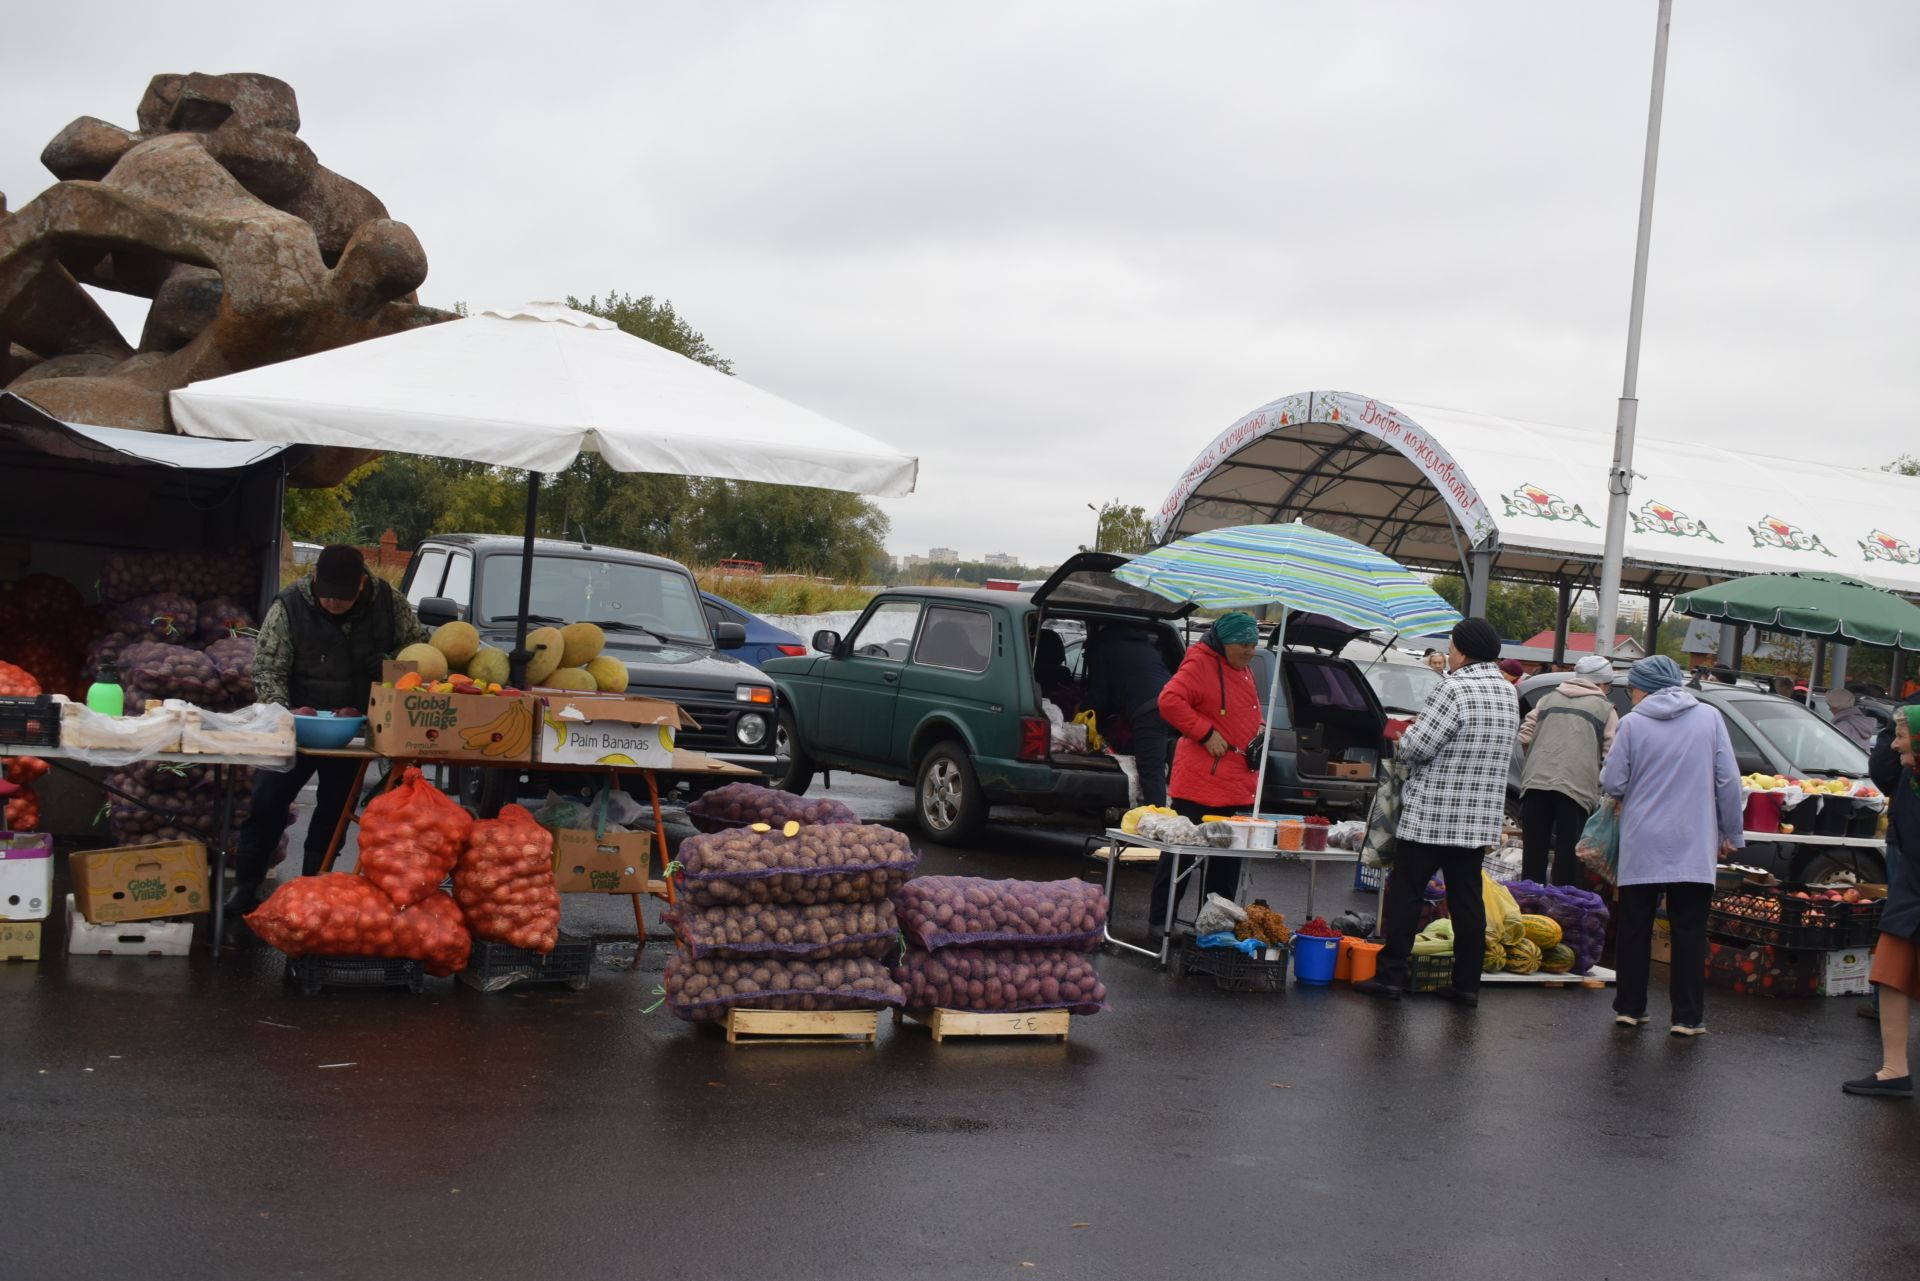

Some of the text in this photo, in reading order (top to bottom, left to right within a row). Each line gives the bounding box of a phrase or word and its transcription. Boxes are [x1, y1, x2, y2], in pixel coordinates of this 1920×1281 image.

[1359, 399, 1477, 515] Добро пожаловать!
[1161, 413, 1267, 523] Ярмарочная площадка
[404, 695, 451, 713] Global
[408, 710, 458, 730] Village
[570, 732, 649, 751] Palm Bananas
[127, 876, 162, 892] Global
[590, 870, 619, 880] Global
[131, 887, 168, 902] Village
